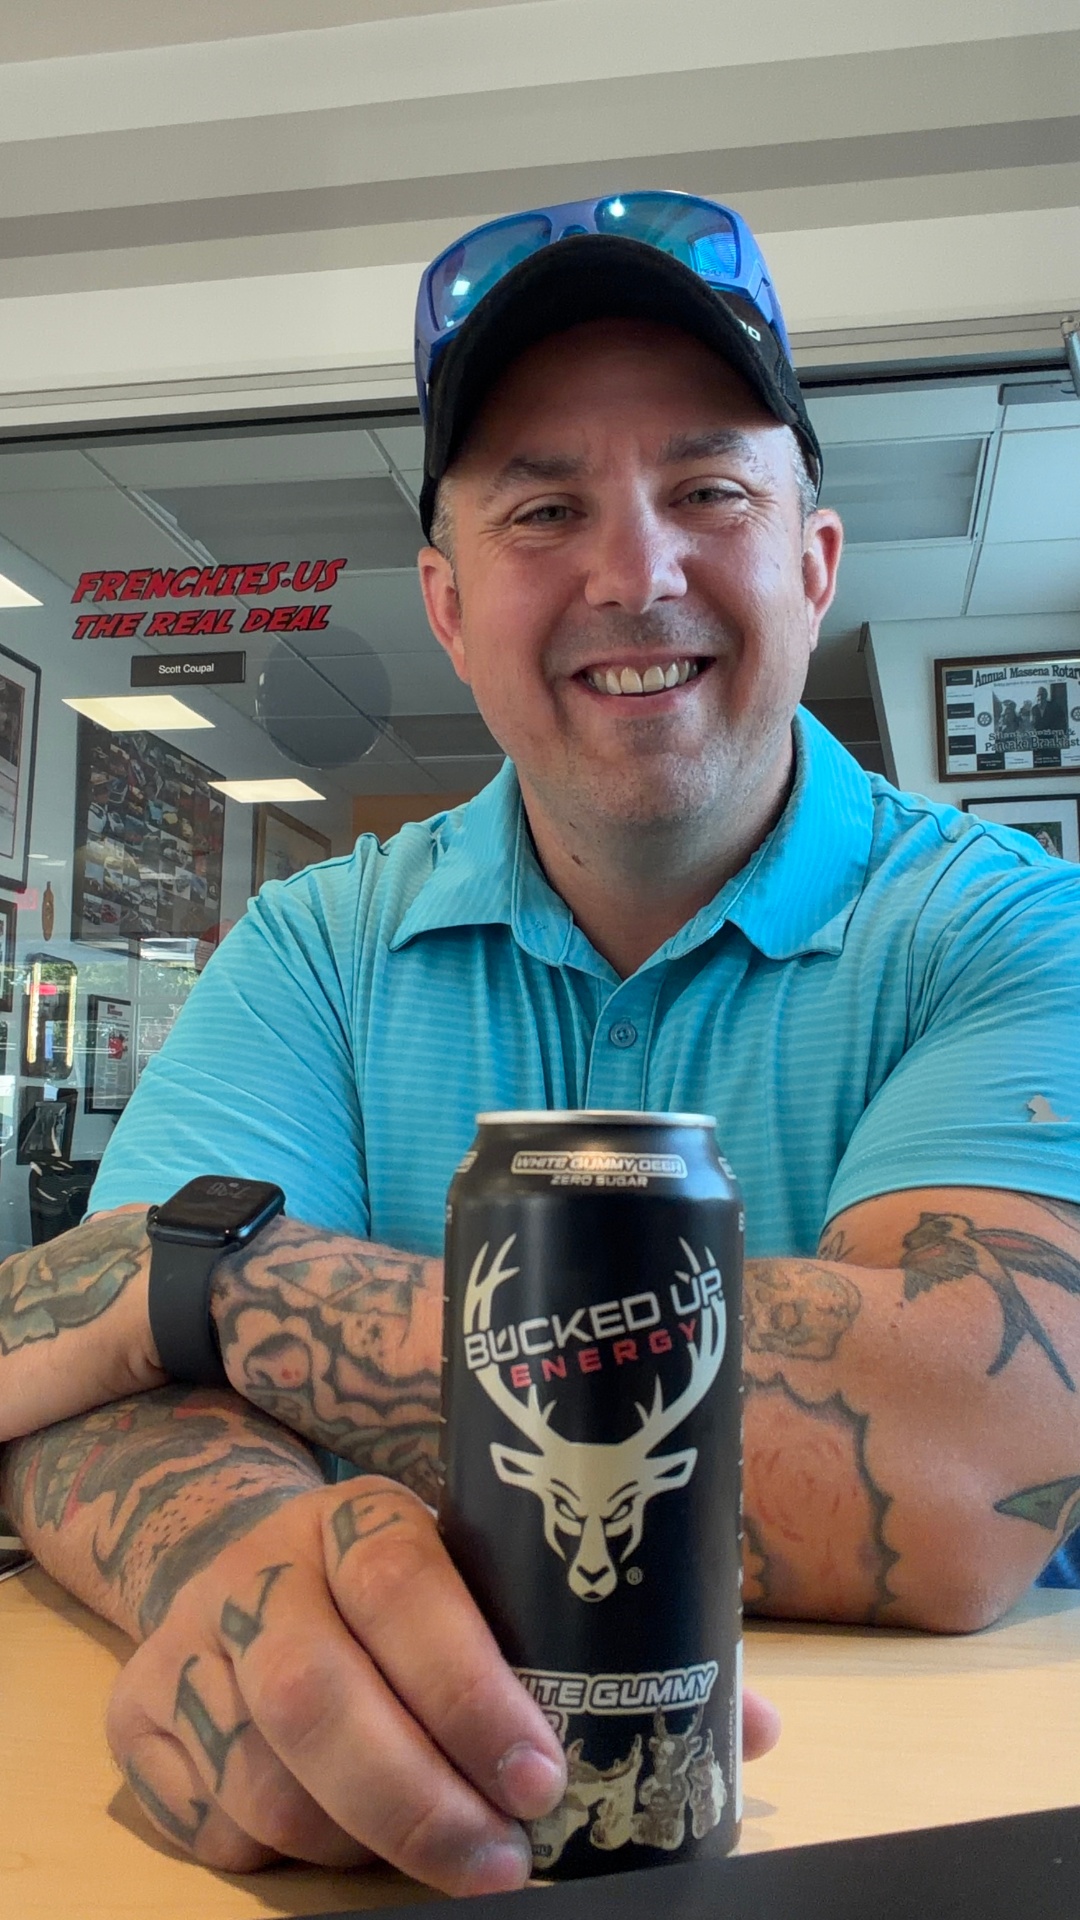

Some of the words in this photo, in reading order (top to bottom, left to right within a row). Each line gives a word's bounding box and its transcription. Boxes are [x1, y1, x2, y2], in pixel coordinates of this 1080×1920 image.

[71, 558, 348, 603] FRENCHIES.US
[72, 612, 147, 640] THE
[145, 608, 236, 637] REAL
[240, 605, 332, 634] DEAL
[158, 664, 182, 675] Scott
[183, 662, 215, 676] Coupal
[975, 668, 1007, 688] Annual
[1010, 667, 1050, 678] Massena
[985, 737, 1029, 752] Pancake
[1031, 735, 1080, 750] Breakfast
[514, 1154, 567, 1170] WHITE
[569, 1154, 637, 1173] GUMMY
[638, 1159, 682, 1174] DEER
[550, 1174, 593, 1187] ZERO
[595, 1175, 649, 1188] SUGAR
[464, 1290, 661, 1370] BUCKED
[509, 1318, 699, 1389] ENERGY
[519, 1675, 586, 1707] ITE
[591, 1668, 716, 1708] GUMMY
